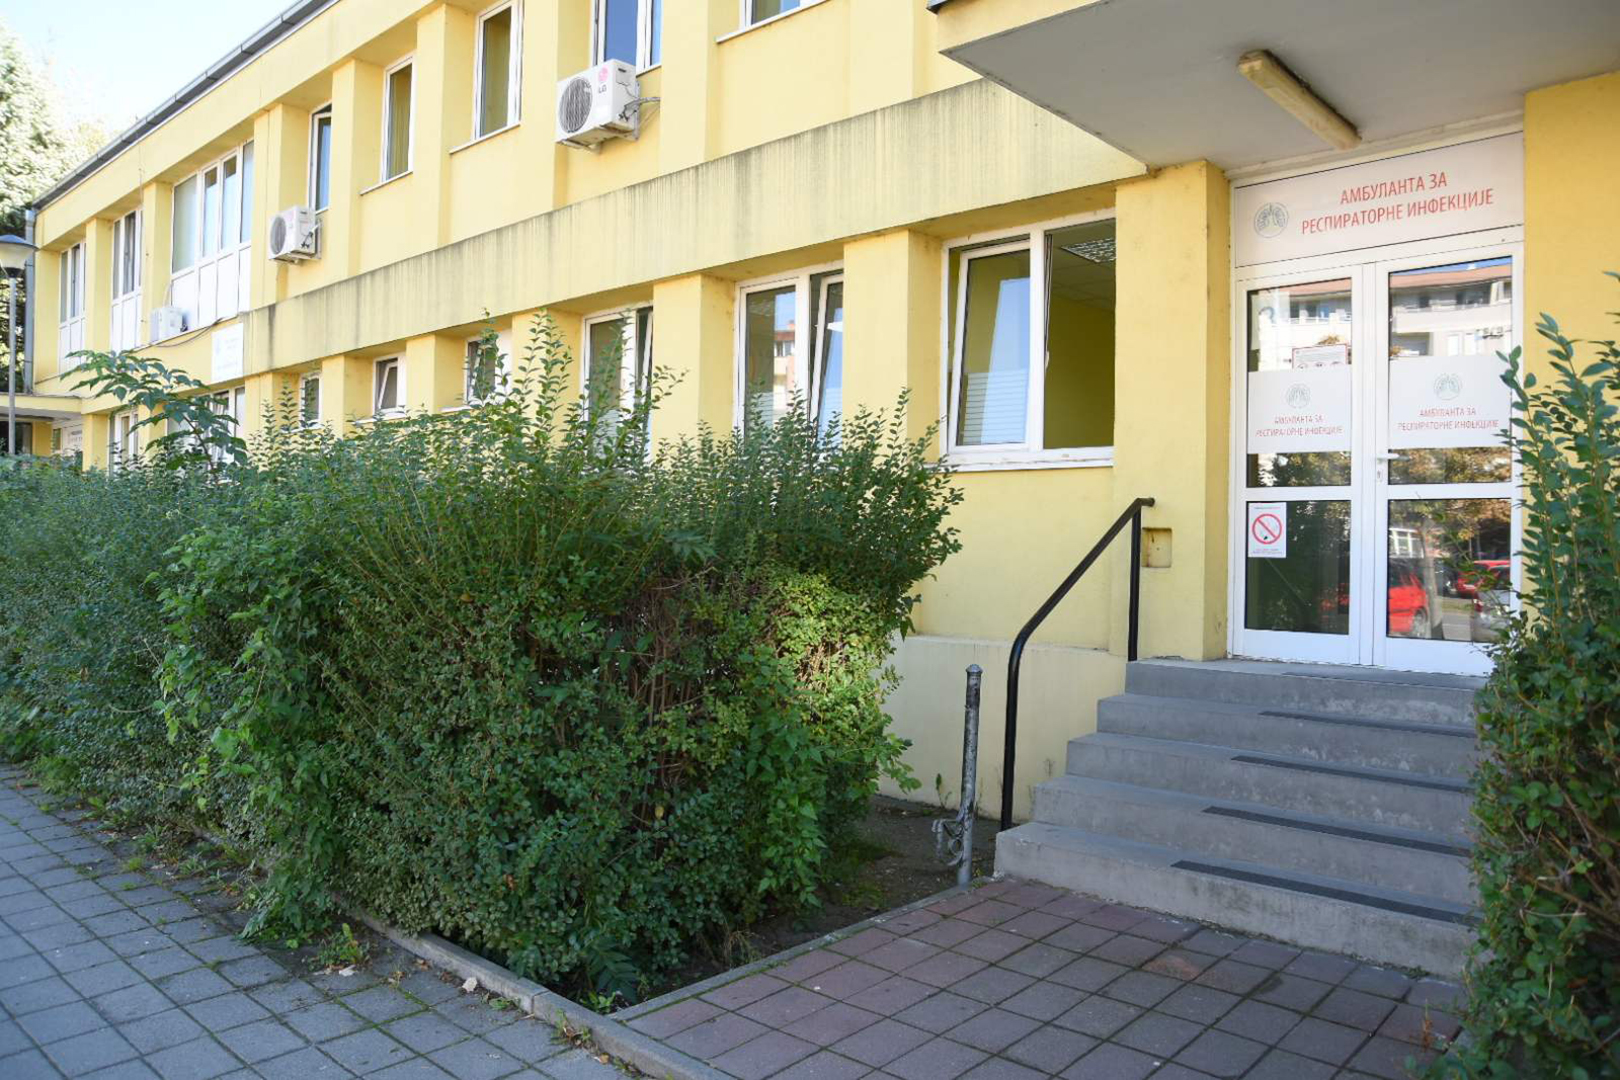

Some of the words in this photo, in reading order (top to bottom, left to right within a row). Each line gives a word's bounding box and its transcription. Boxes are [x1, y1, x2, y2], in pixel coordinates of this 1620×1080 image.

[1340, 176, 1425, 205] АМБУЛАНТА
[1428, 172, 1448, 190] ЗА
[1302, 203, 1403, 235] РЕСПИРАТОРНЕ
[1406, 188, 1494, 218] ИНФЕКЦИЈЕ
